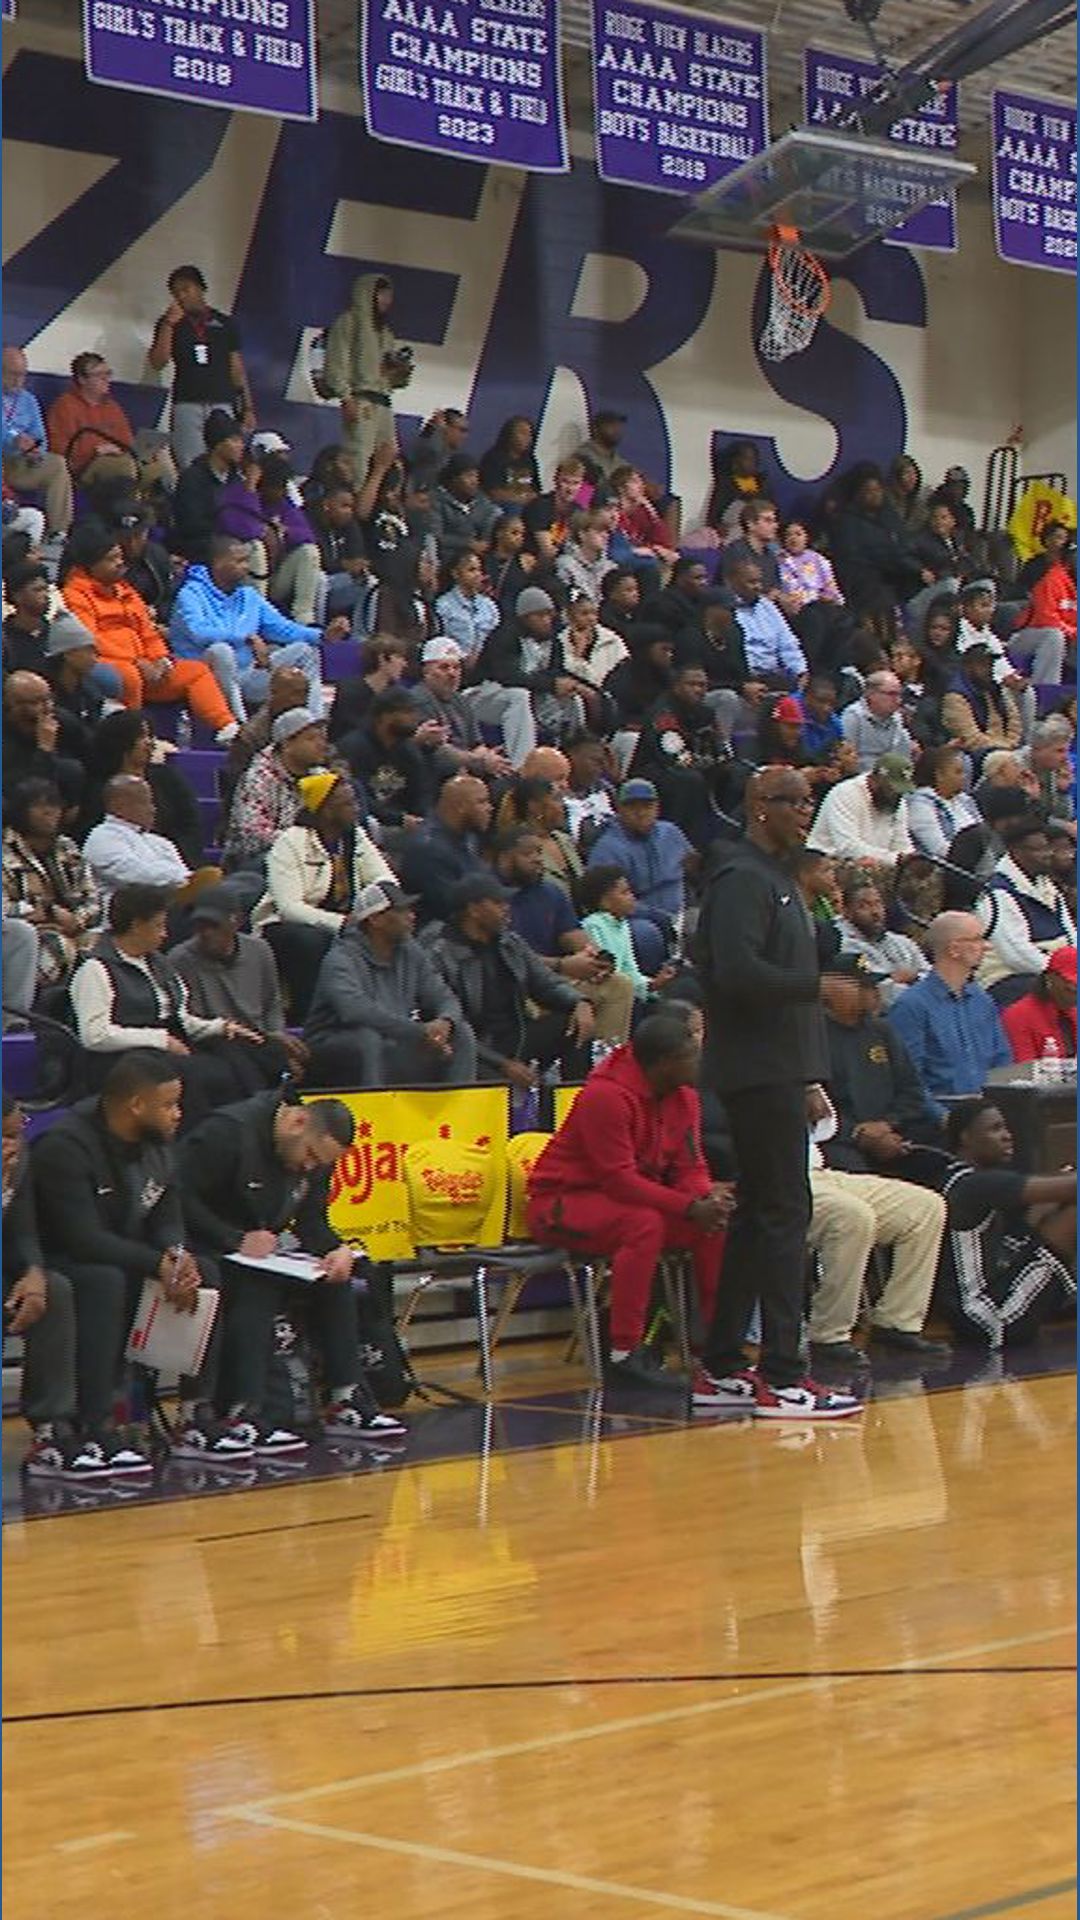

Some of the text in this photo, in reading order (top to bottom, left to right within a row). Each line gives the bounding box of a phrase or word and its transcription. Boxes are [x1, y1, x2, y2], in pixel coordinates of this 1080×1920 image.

[92, 2, 305, 69] GIRL'S TRACK & FIELD
[382, 0, 548, 55] AAAA STATE
[604, 10, 754, 66] RIDGE VIEW BLAZERS
[172, 55, 233, 87] 2018
[389, 31, 542, 88] CHAMPIONS
[598, 43, 761, 99] AAAA STATE
[431, 77, 485, 113] TRACK
[489, 90, 504, 116] &
[611, 78, 749, 128] CHAMPIONS
[437, 114, 496, 145] 2023
[656, 121, 755, 161] BASKETBALL
[999, 135, 1060, 171] AAAA
